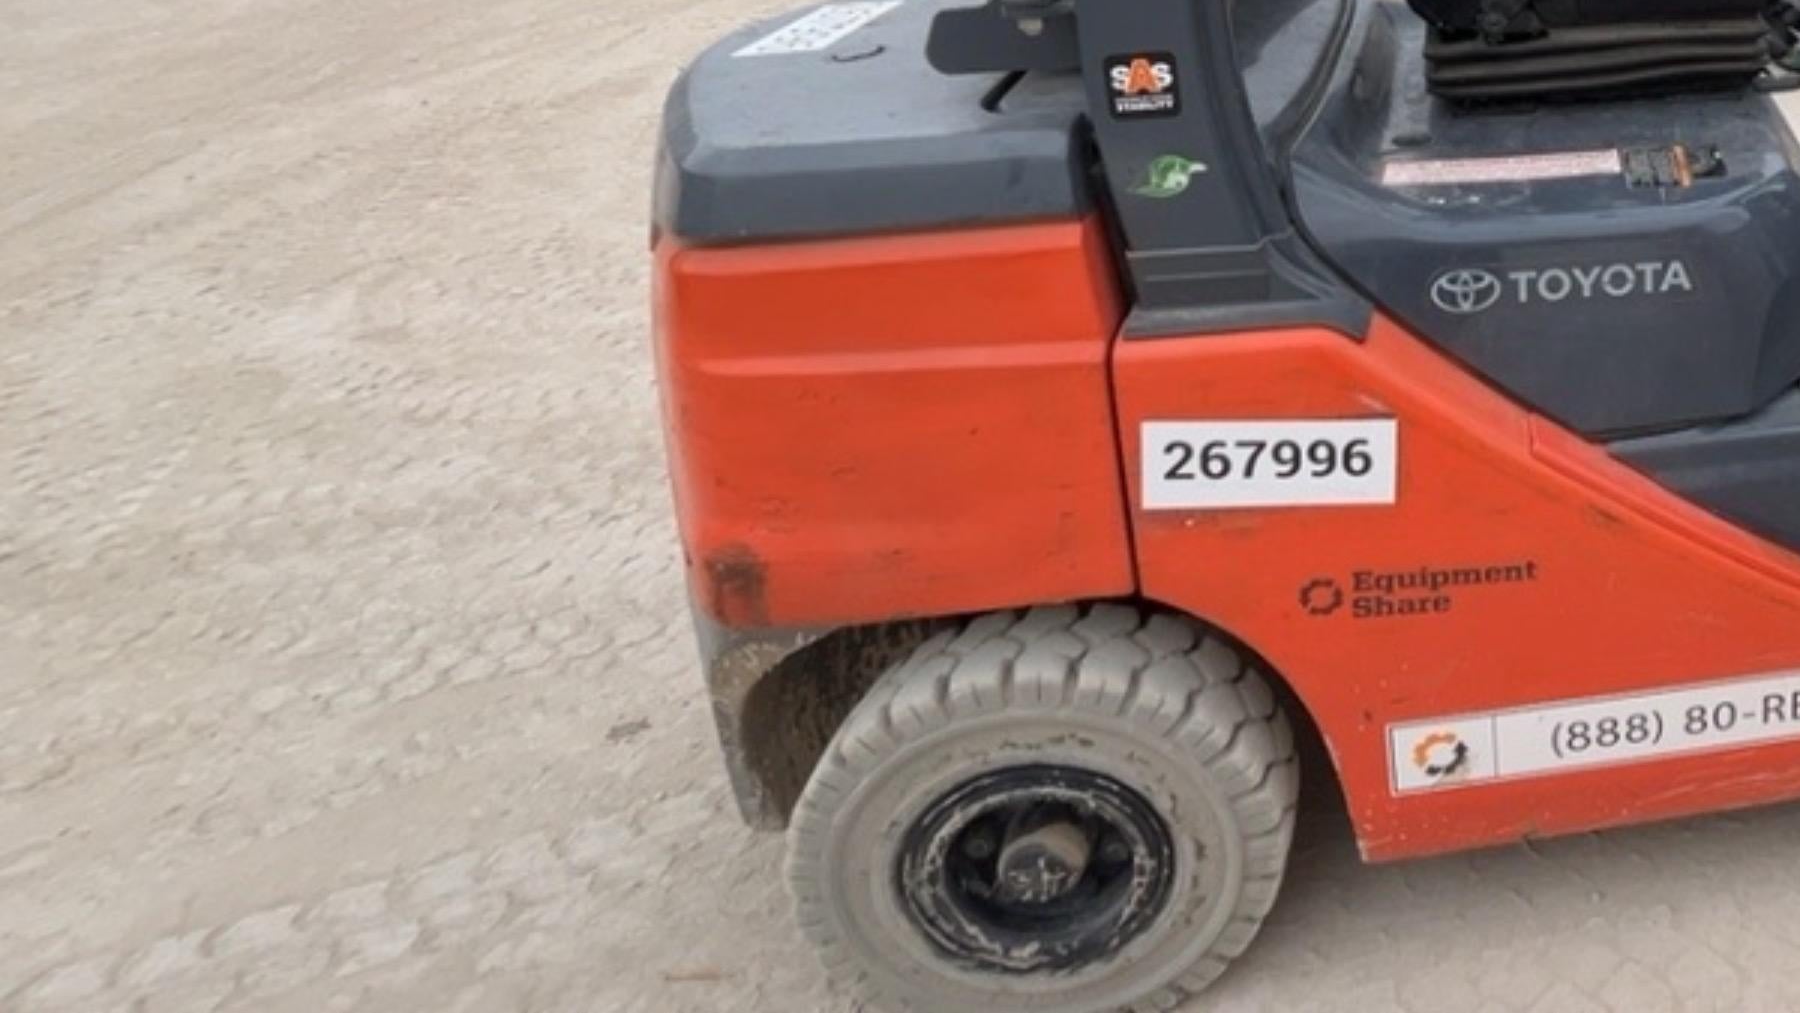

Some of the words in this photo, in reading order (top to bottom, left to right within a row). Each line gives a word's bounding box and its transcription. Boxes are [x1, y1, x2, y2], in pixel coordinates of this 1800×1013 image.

[1109, 57, 1174, 94] SAS
[1508, 260, 1692, 303] TOYOTA
[1162, 438, 1373, 481] 267996
[1351, 560, 1537, 594] Equipment
[1351, 593, 1452, 619] Share
[1550, 710, 1665, 758] (888)
